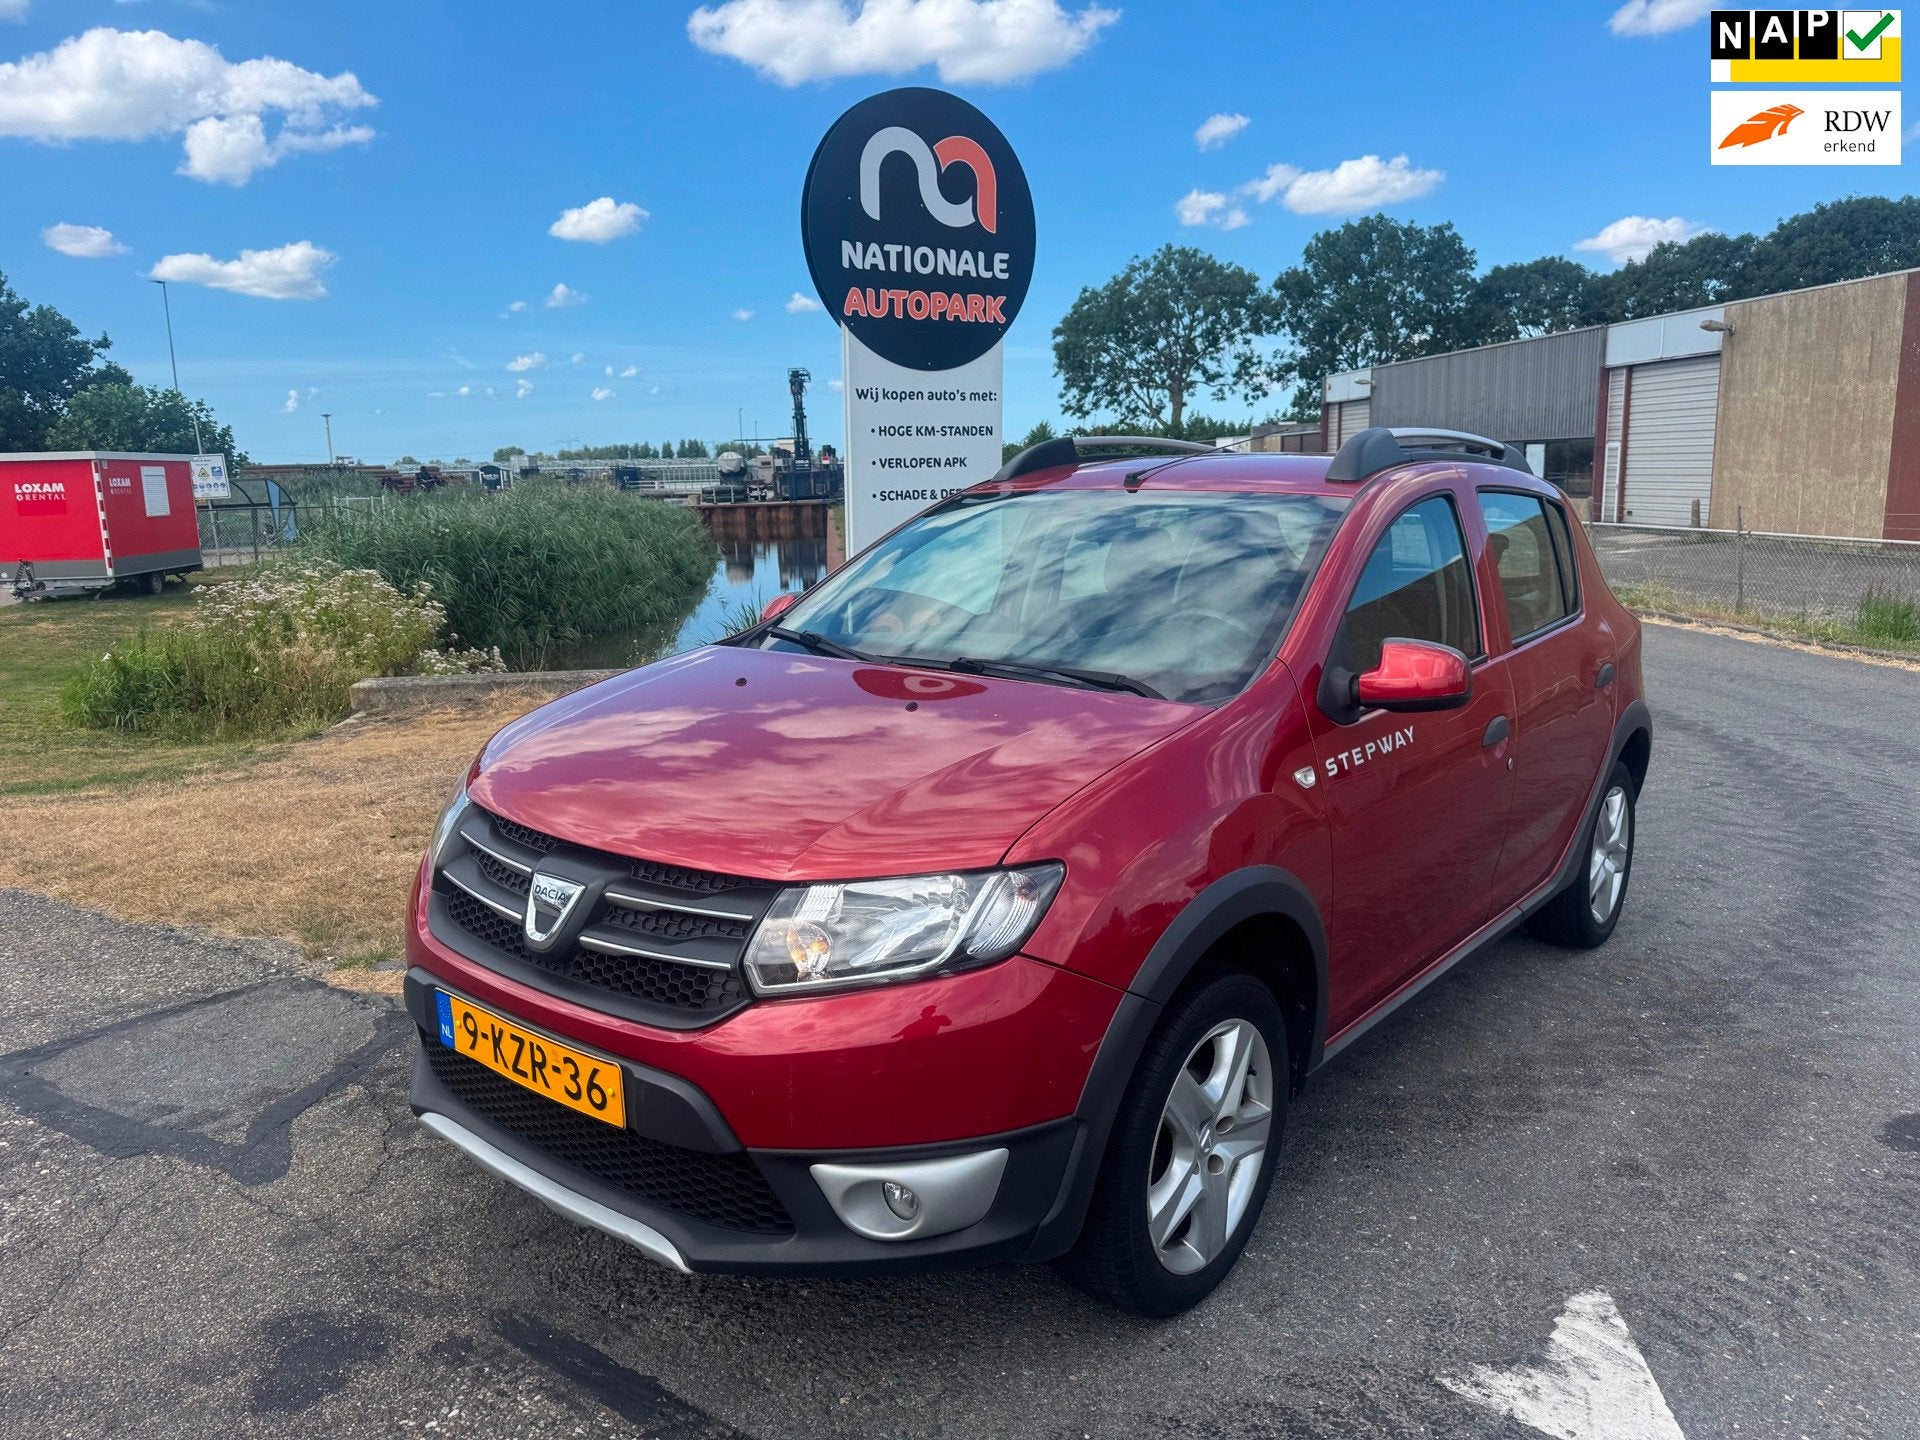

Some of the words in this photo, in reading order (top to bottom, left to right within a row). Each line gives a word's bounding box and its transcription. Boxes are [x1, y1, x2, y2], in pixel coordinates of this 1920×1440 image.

[841, 240, 1010, 280] NATIONALE
[844, 286, 1007, 324] AUTOPARK
[855, 388, 878, 402] Wij
[882, 388, 924, 402] kopen
[927, 389, 966, 401] auto's
[969, 390, 997, 402] met:
[879, 425, 912, 437] HOGE
[916, 425, 993, 437] KM-STANDEN
[879, 457, 942, 469] VERLOPEN
[943, 456, 967, 468] APK
[14, 483, 65, 493] LOXAM
[109, 478, 131, 487] LOXAM
[879, 489, 927, 501] SCHADE
[930, 489, 938, 500] &
[1325, 726, 1414, 777] STEPWAY
[534, 885, 567, 902] DACIA
[441, 1023, 453, 1039] NL
[462, 1011, 608, 1111] 9-KZR-36
